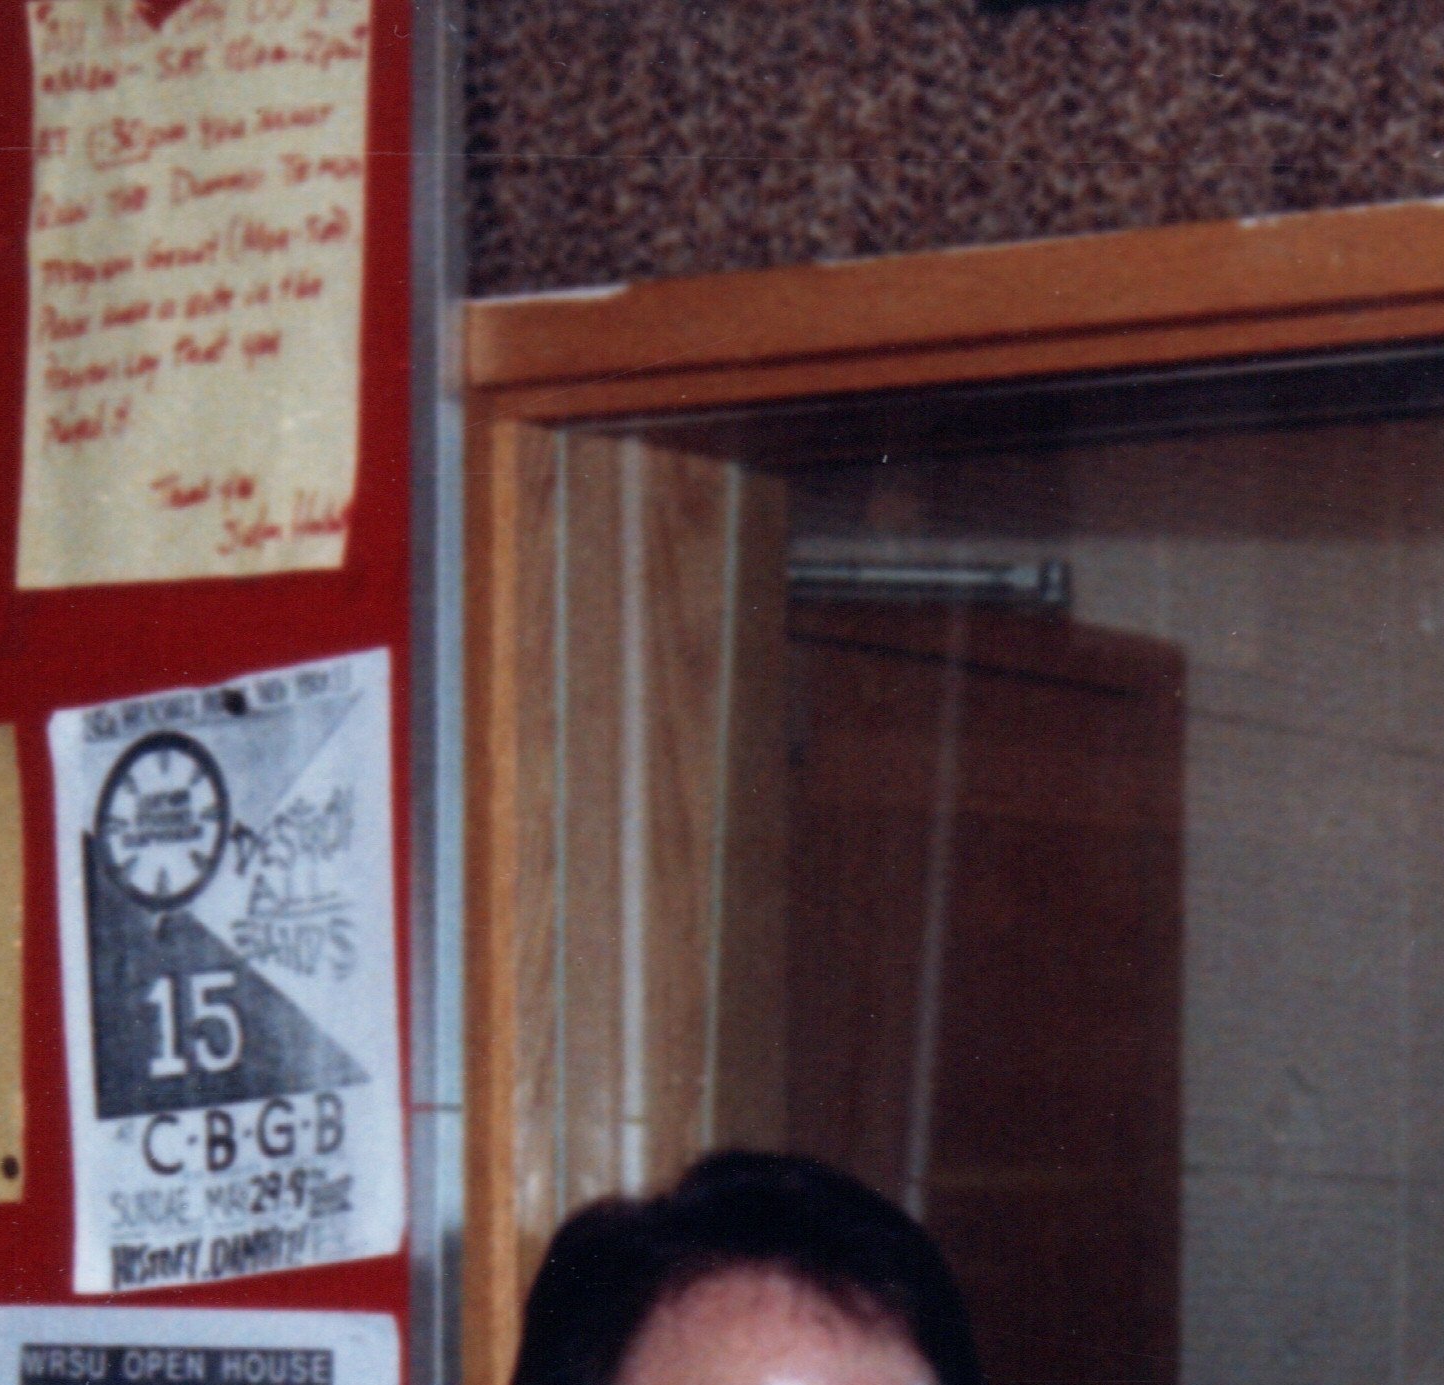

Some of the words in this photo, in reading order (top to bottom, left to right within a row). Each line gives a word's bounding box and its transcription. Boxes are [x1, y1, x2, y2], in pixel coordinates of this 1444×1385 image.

[146, 970, 244, 1080] 15
[23, 1349, 107, 1379] WRSU
[123, 1351, 206, 1382] OPEN
[221, 1354, 331, 1385] HOUSE
